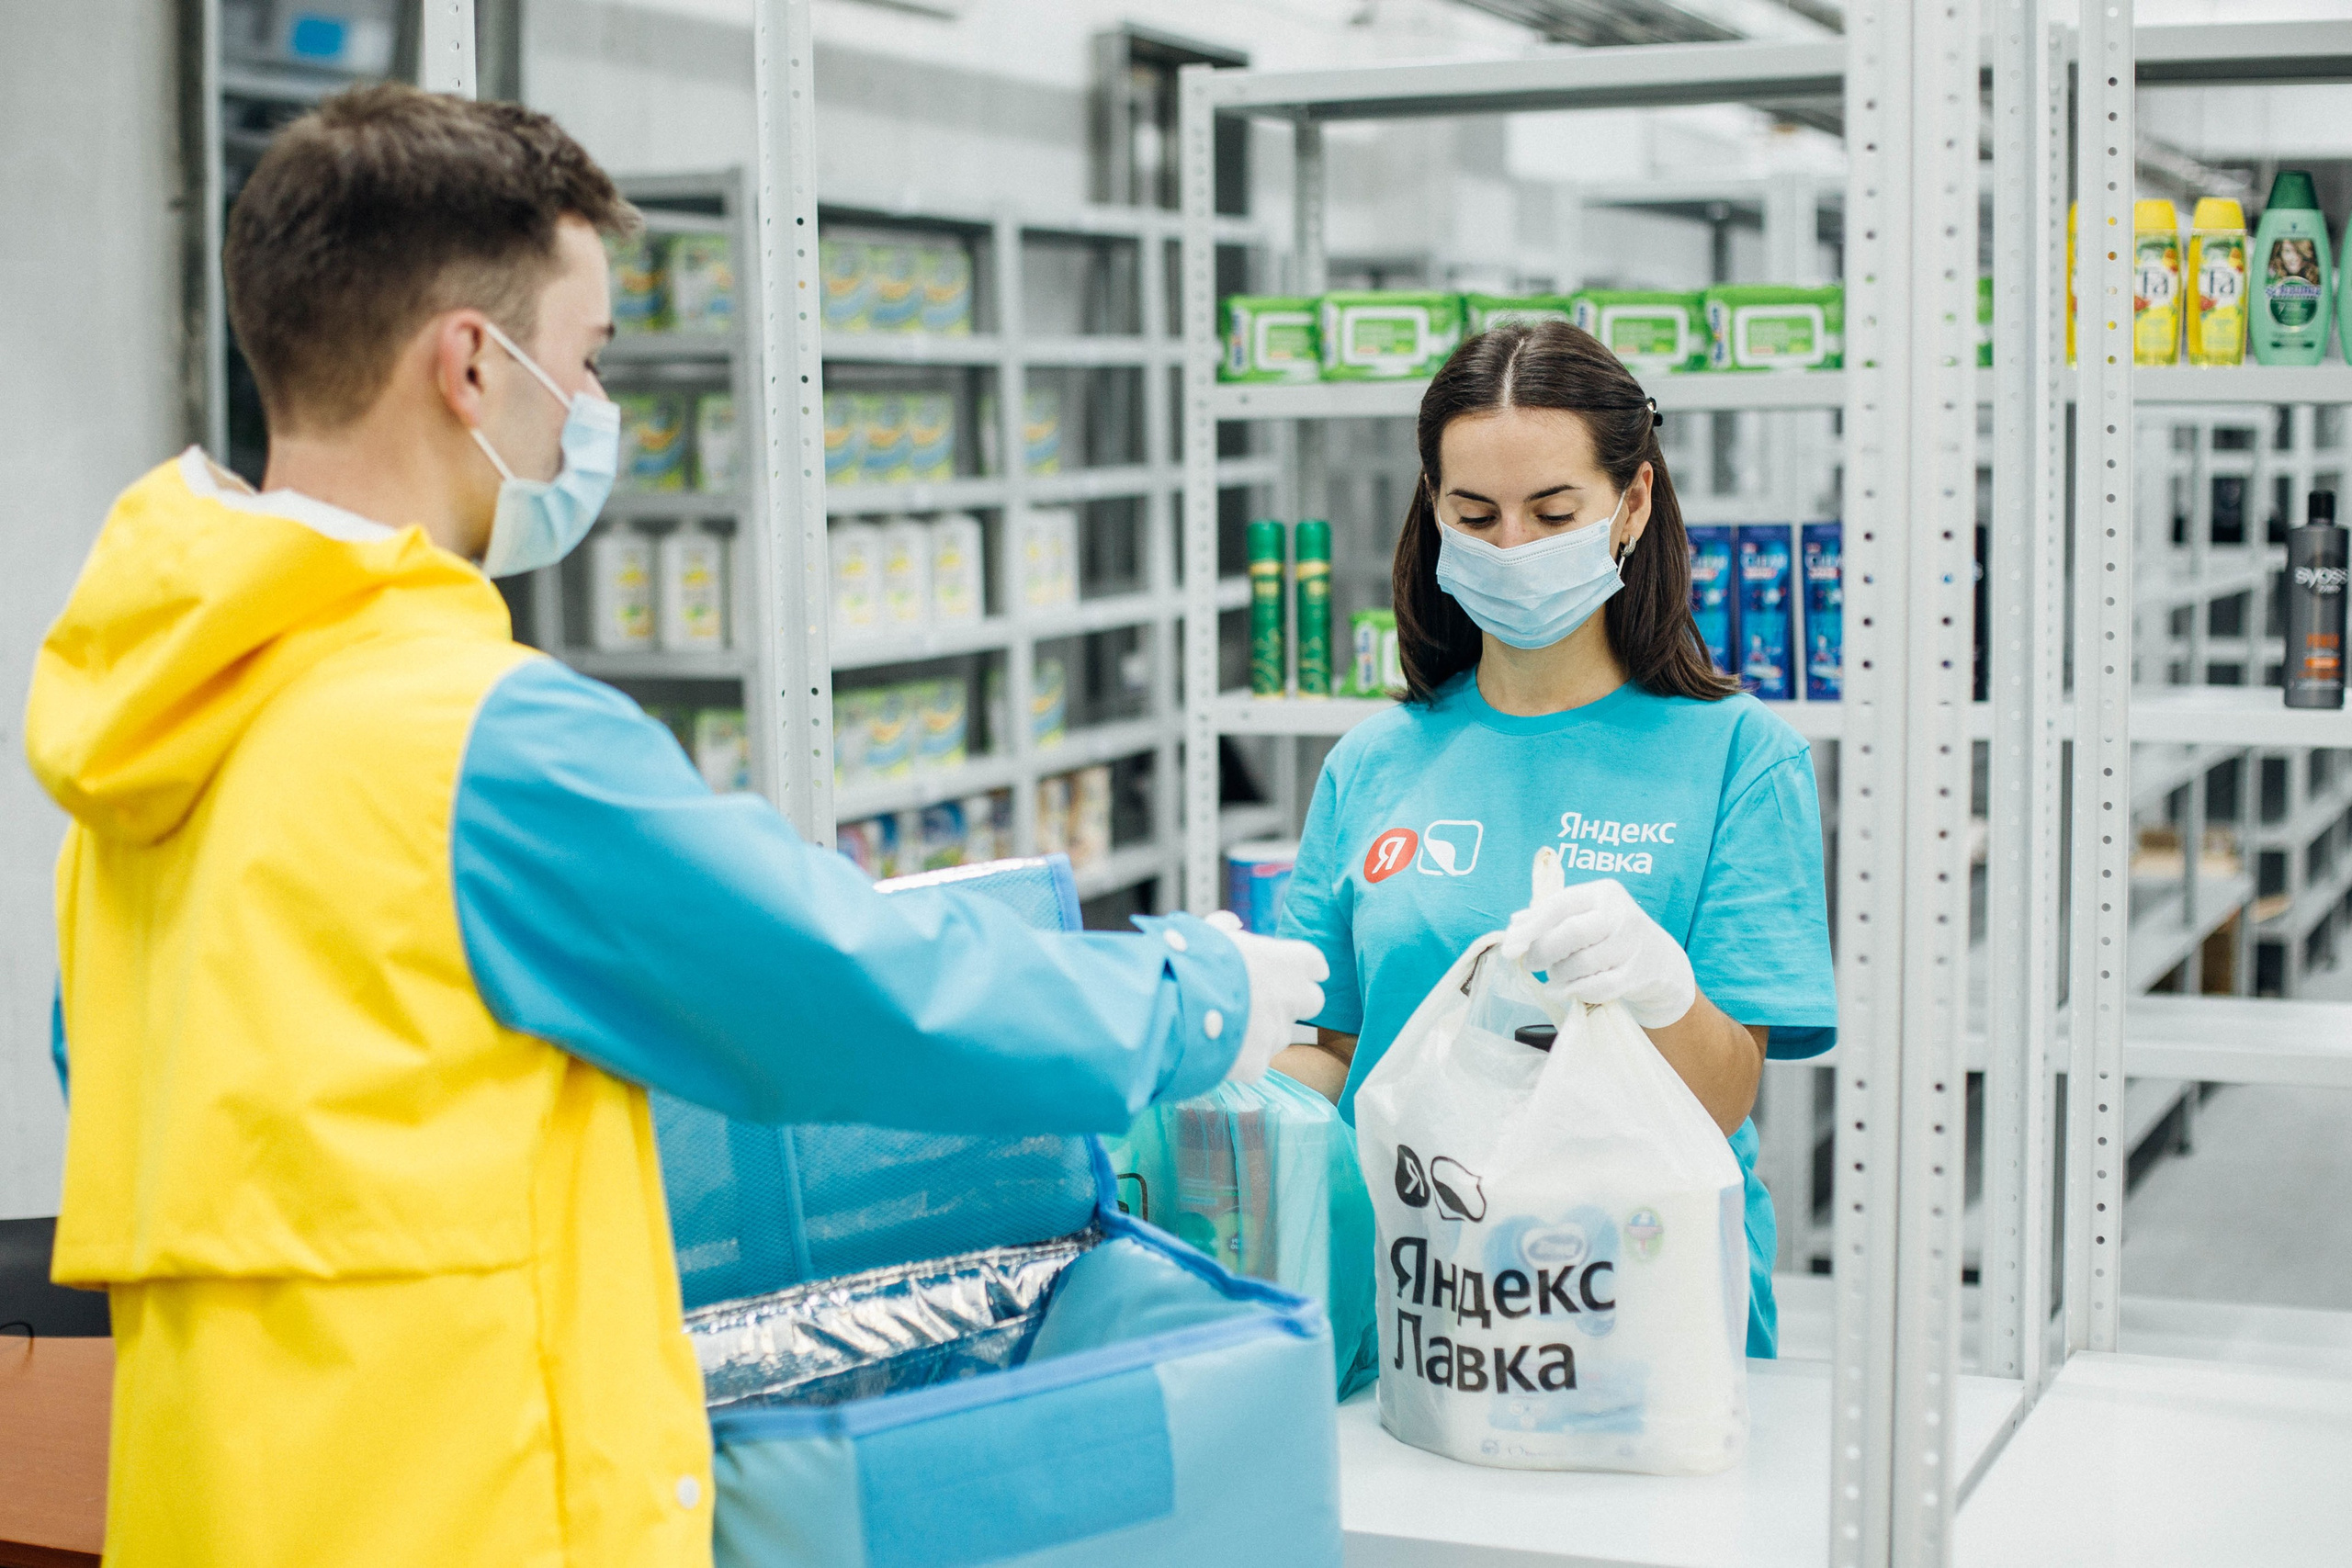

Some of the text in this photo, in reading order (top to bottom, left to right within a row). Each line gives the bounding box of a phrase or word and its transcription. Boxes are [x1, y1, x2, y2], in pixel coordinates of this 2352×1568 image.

[1557, 811, 1677, 846] Яндекс
[1372, 836, 1408, 874] Я
[1558, 842, 1653, 874] Лавка
[1390, 1236, 1616, 1329] Яндекс
[1394, 1307, 1577, 1393] Лавка
